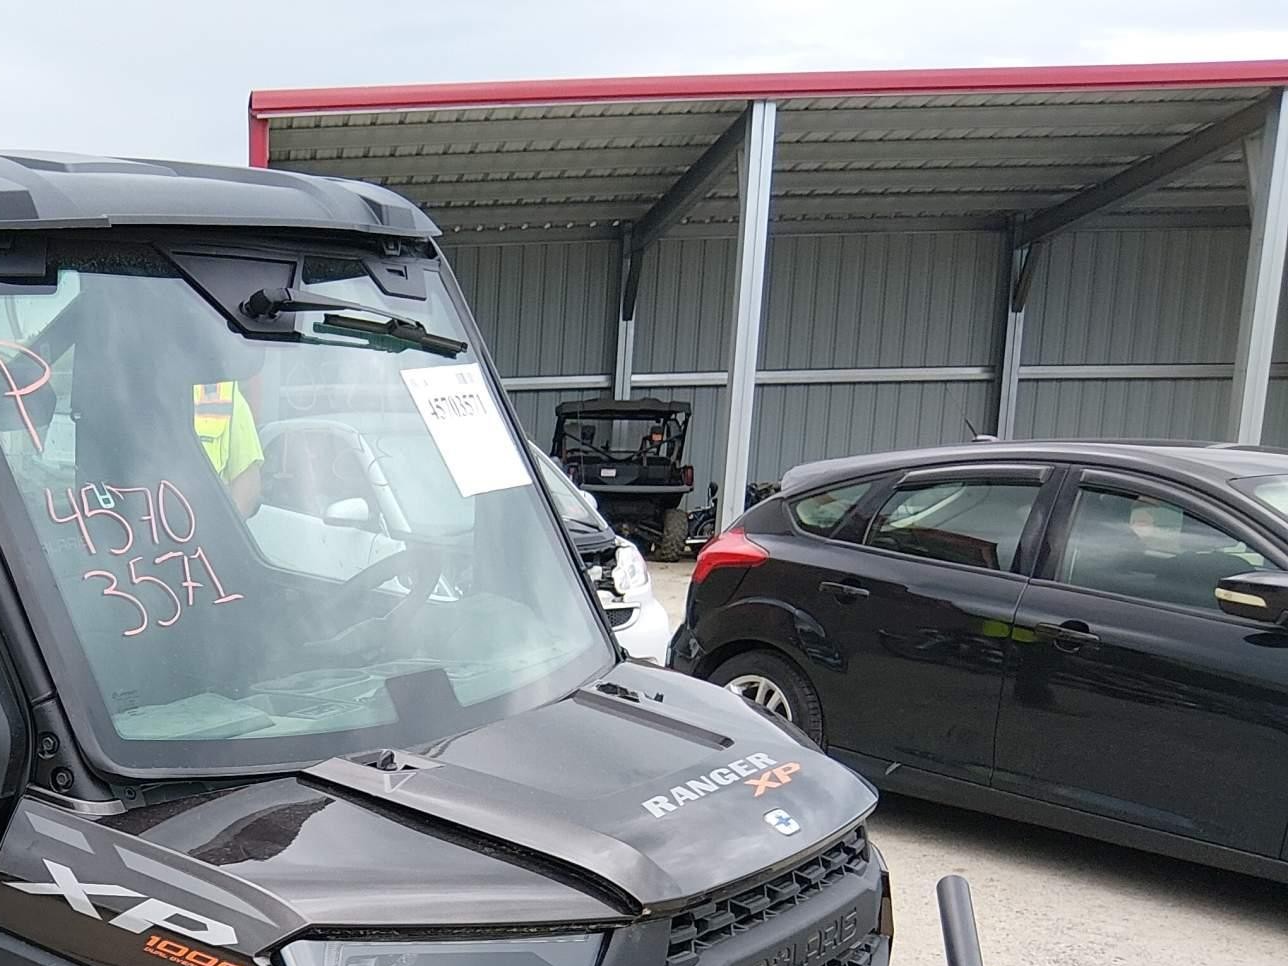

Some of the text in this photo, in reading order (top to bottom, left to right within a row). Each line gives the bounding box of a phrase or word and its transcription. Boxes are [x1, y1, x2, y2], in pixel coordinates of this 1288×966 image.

[45, 480, 196, 554] 4570
[84, 547, 245, 636] 3571
[641, 752, 778, 818] RANGER
[743, 762, 801, 798] XP
[1, 858, 239, 946] XP
